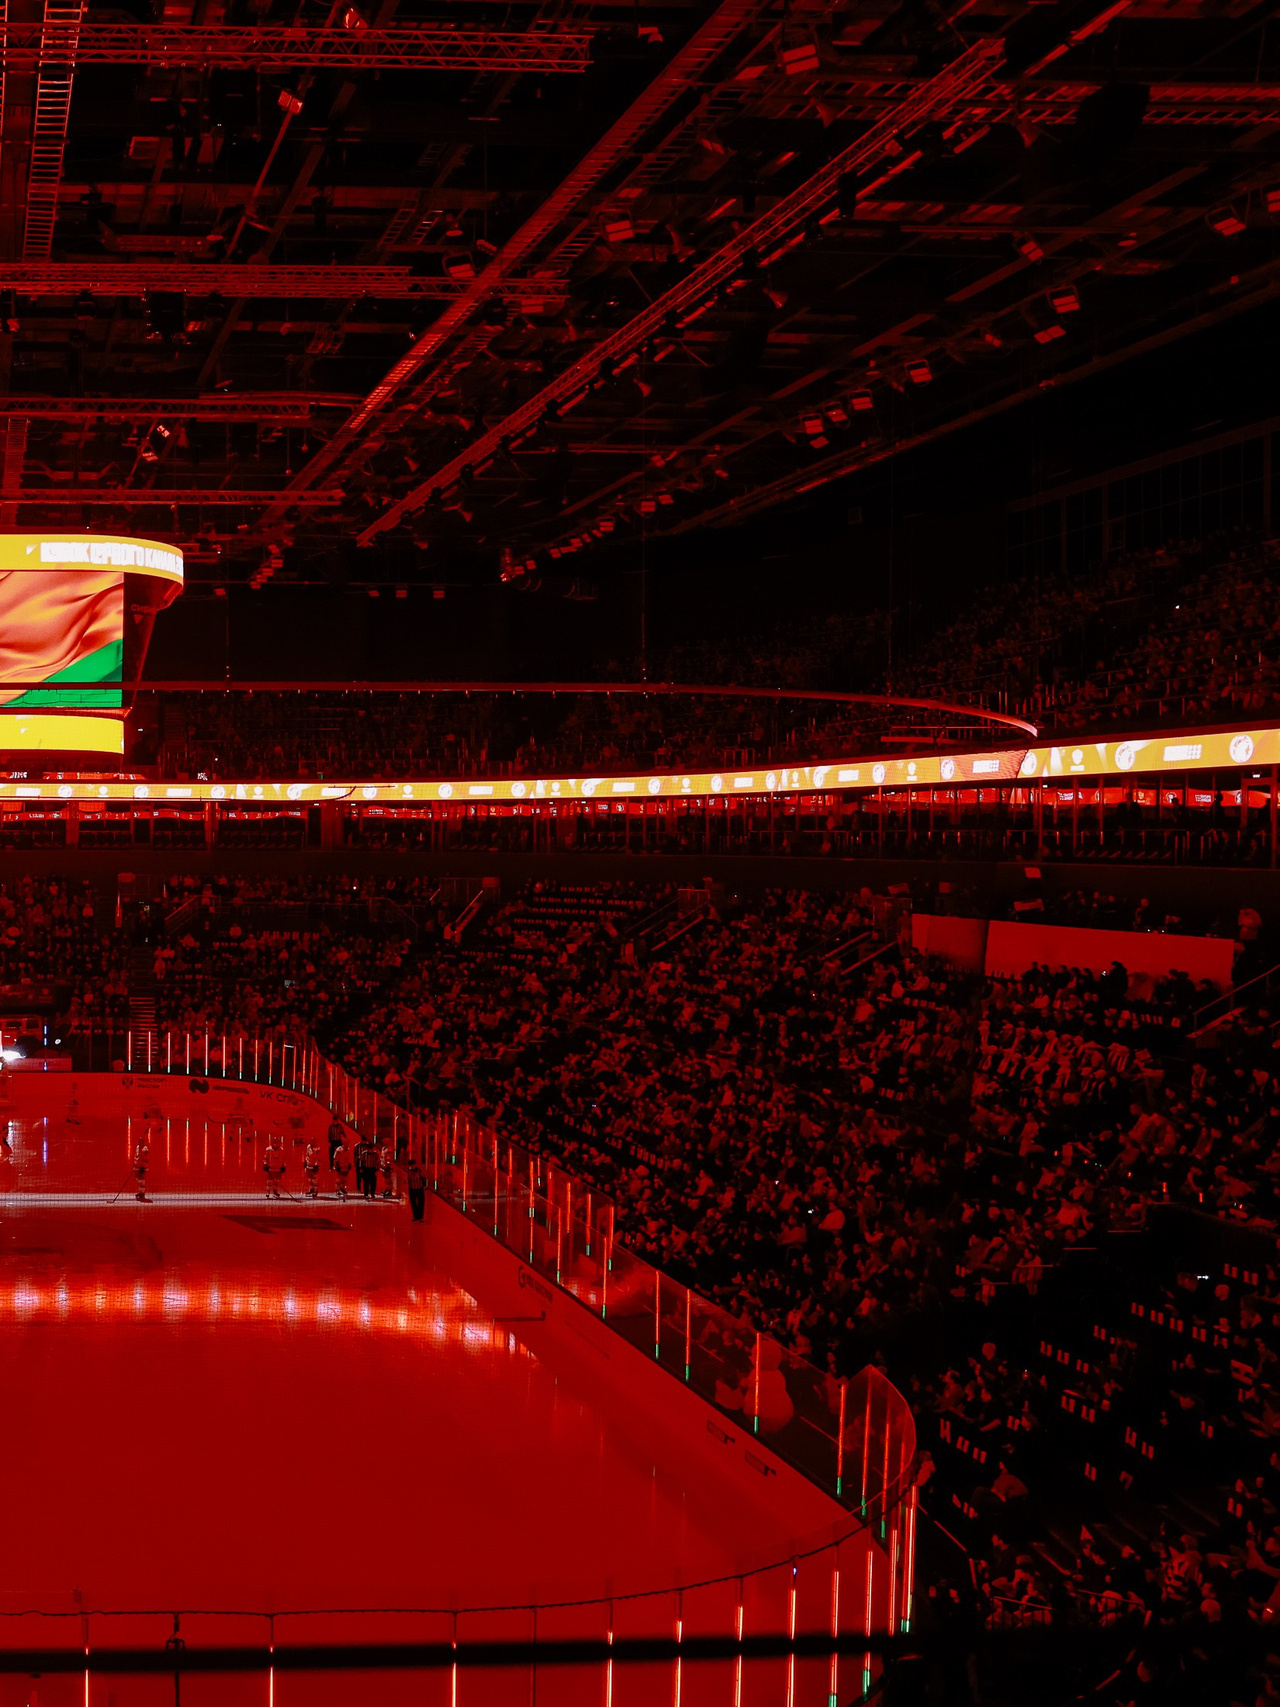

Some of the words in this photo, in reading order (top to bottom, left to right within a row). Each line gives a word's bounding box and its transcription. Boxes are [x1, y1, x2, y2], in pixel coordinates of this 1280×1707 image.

[90, 542, 145, 567] ПЕРВОГО
[145, 547, 176, 574] КАНАЛА
[260, 1090, 274, 1101] VK
